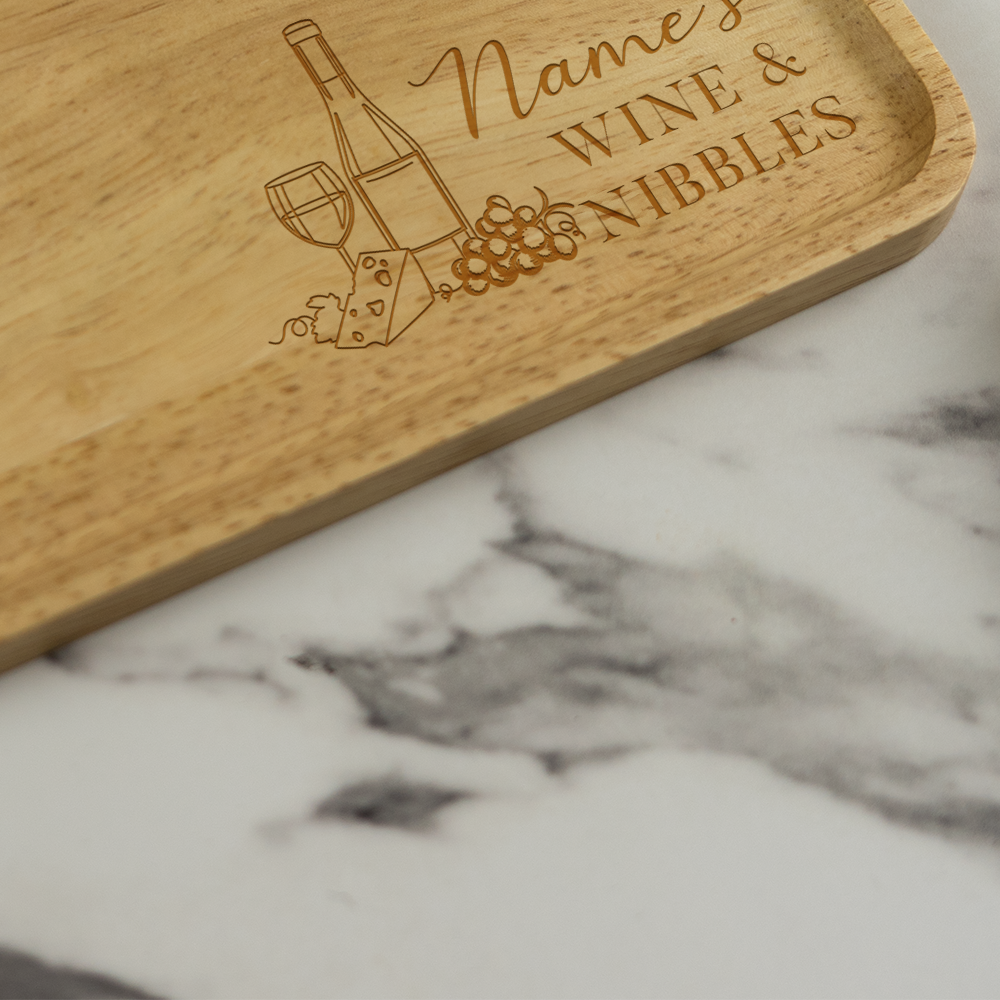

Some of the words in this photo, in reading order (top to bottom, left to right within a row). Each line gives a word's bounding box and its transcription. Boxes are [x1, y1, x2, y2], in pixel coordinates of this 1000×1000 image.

[547, 63, 743, 168] WINE
[752, 41, 807, 87] &
[577, 93, 858, 243] NIBBLES
